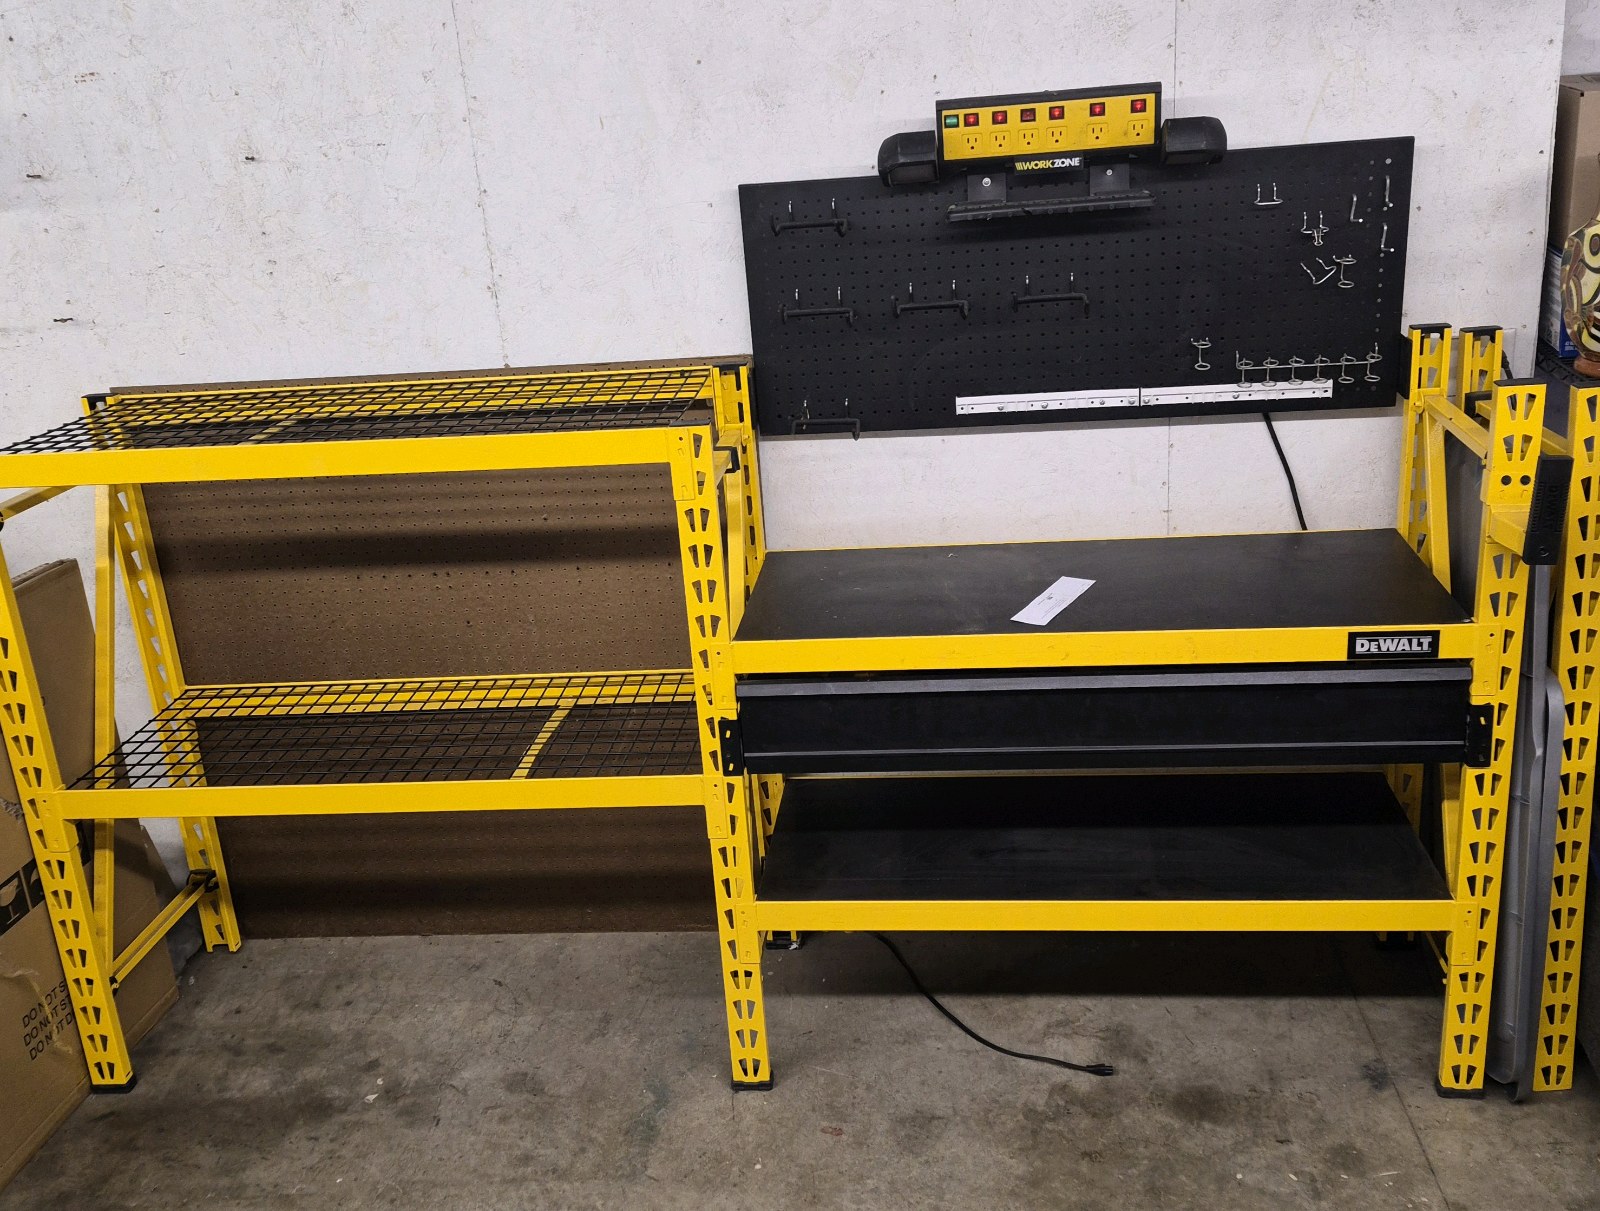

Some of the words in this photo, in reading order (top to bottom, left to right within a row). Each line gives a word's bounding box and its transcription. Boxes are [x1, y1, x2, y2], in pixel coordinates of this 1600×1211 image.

[22, 1008, 37, 1028] DO
[24, 1026, 38, 1046] DO
[29, 1041, 44, 1060] DO
